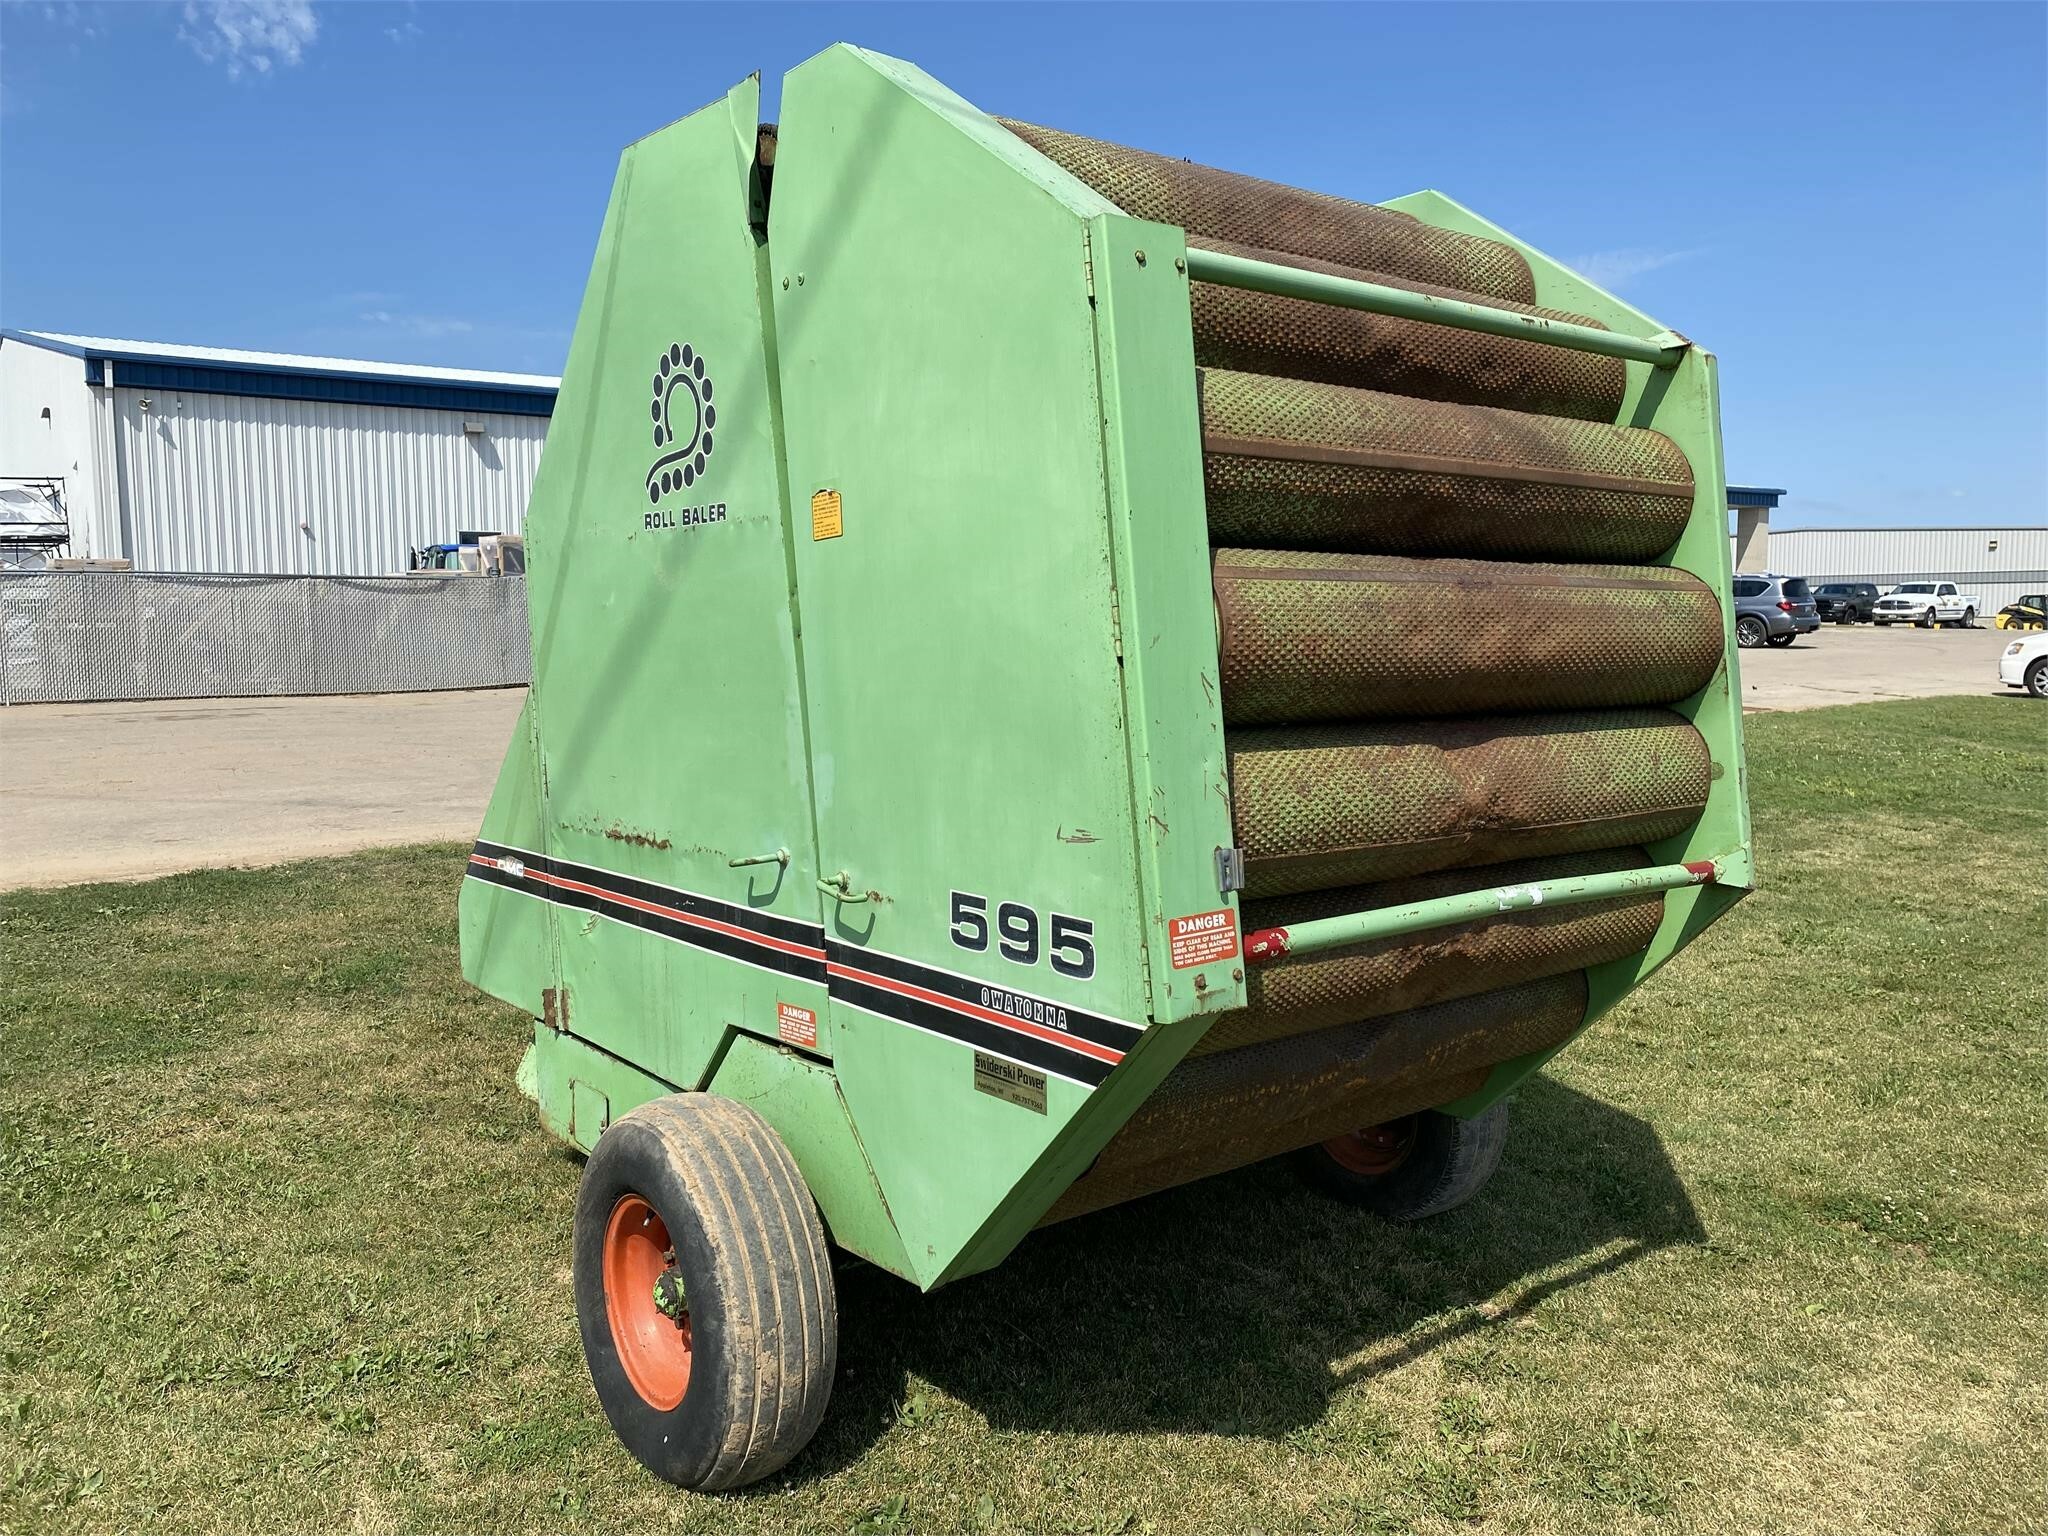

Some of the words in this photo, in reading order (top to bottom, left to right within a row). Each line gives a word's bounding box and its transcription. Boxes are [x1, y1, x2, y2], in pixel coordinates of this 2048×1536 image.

[644, 509, 676, 530] ROLL
[682, 502, 727, 526] BALER
[950, 889, 1096, 981] 595
[1178, 914, 1226, 933] DANGER
[1186, 938, 1201, 946] CLEAR
[782, 1005, 811, 1022] DANGER
[981, 987, 1067, 1030] OWATONNA
[975, 1054, 1016, 1081] Swiderski
[1017, 1067, 1045, 1090] Power
